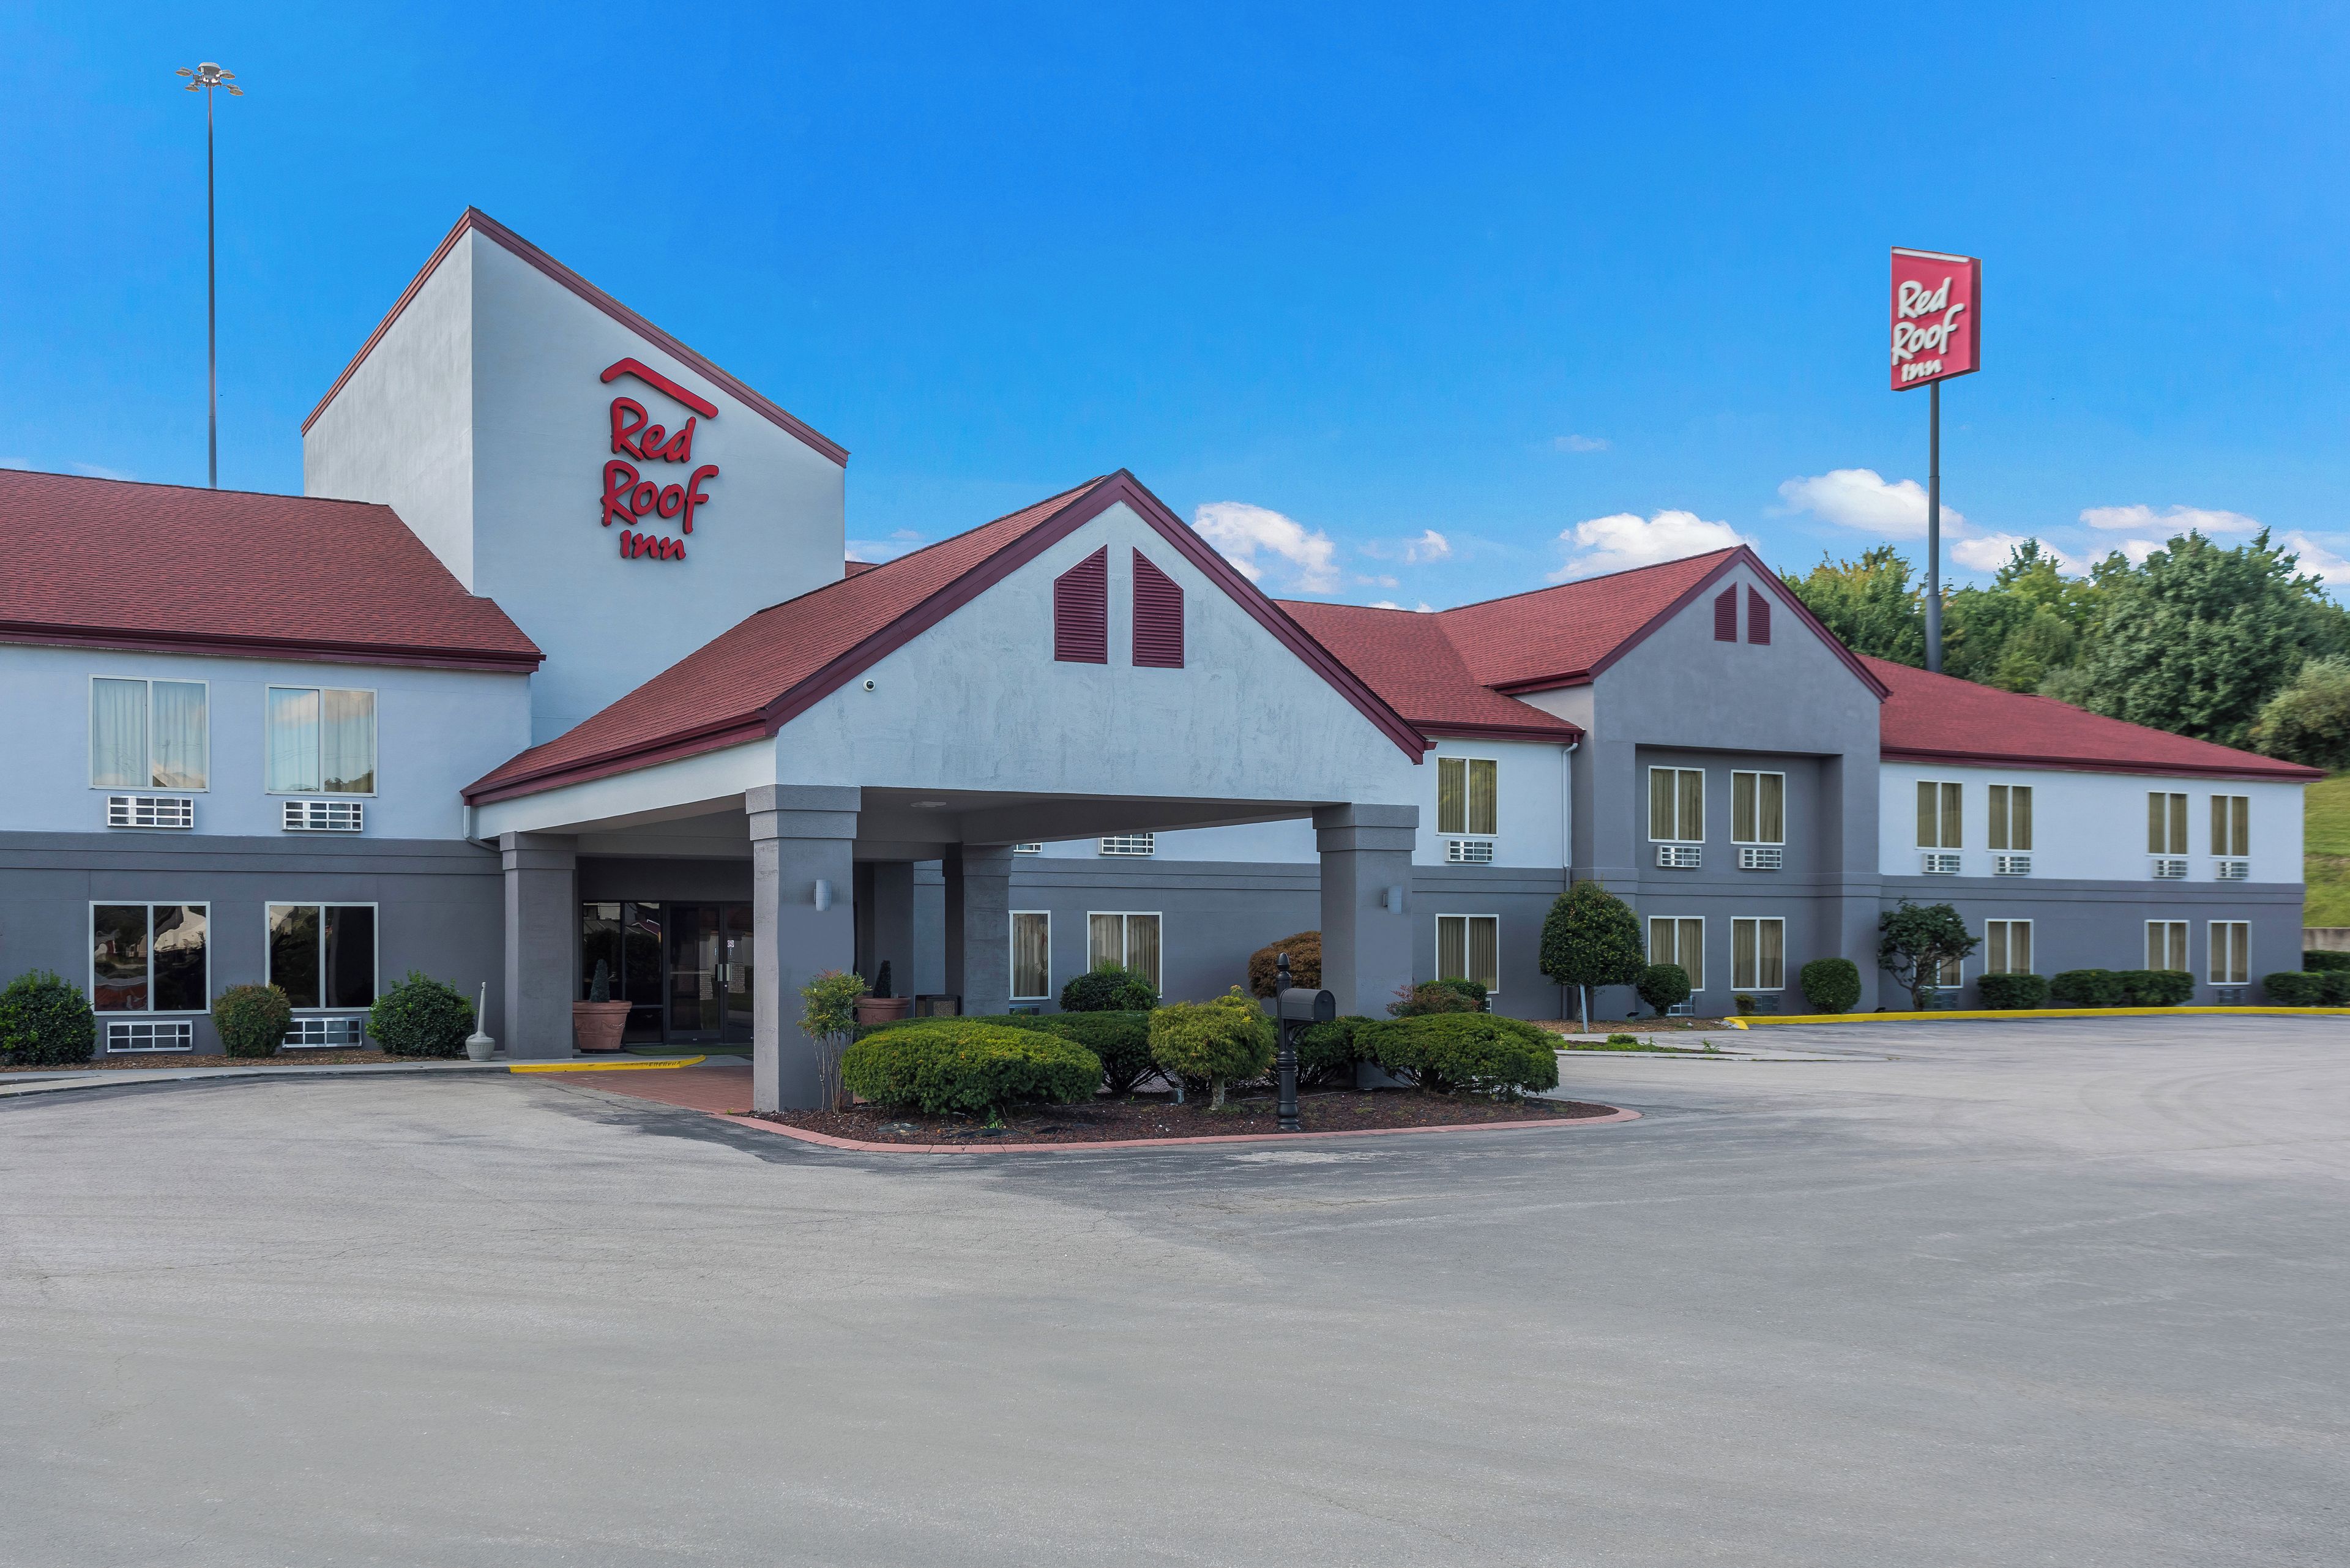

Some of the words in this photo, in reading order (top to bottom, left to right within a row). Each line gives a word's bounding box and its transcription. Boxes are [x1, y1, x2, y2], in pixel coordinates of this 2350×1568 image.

[1898, 277, 1952, 318] Red
[1892, 303, 1966, 366] Roof
[611, 397, 696, 463] Red
[600, 460, 719, 534] Roof
